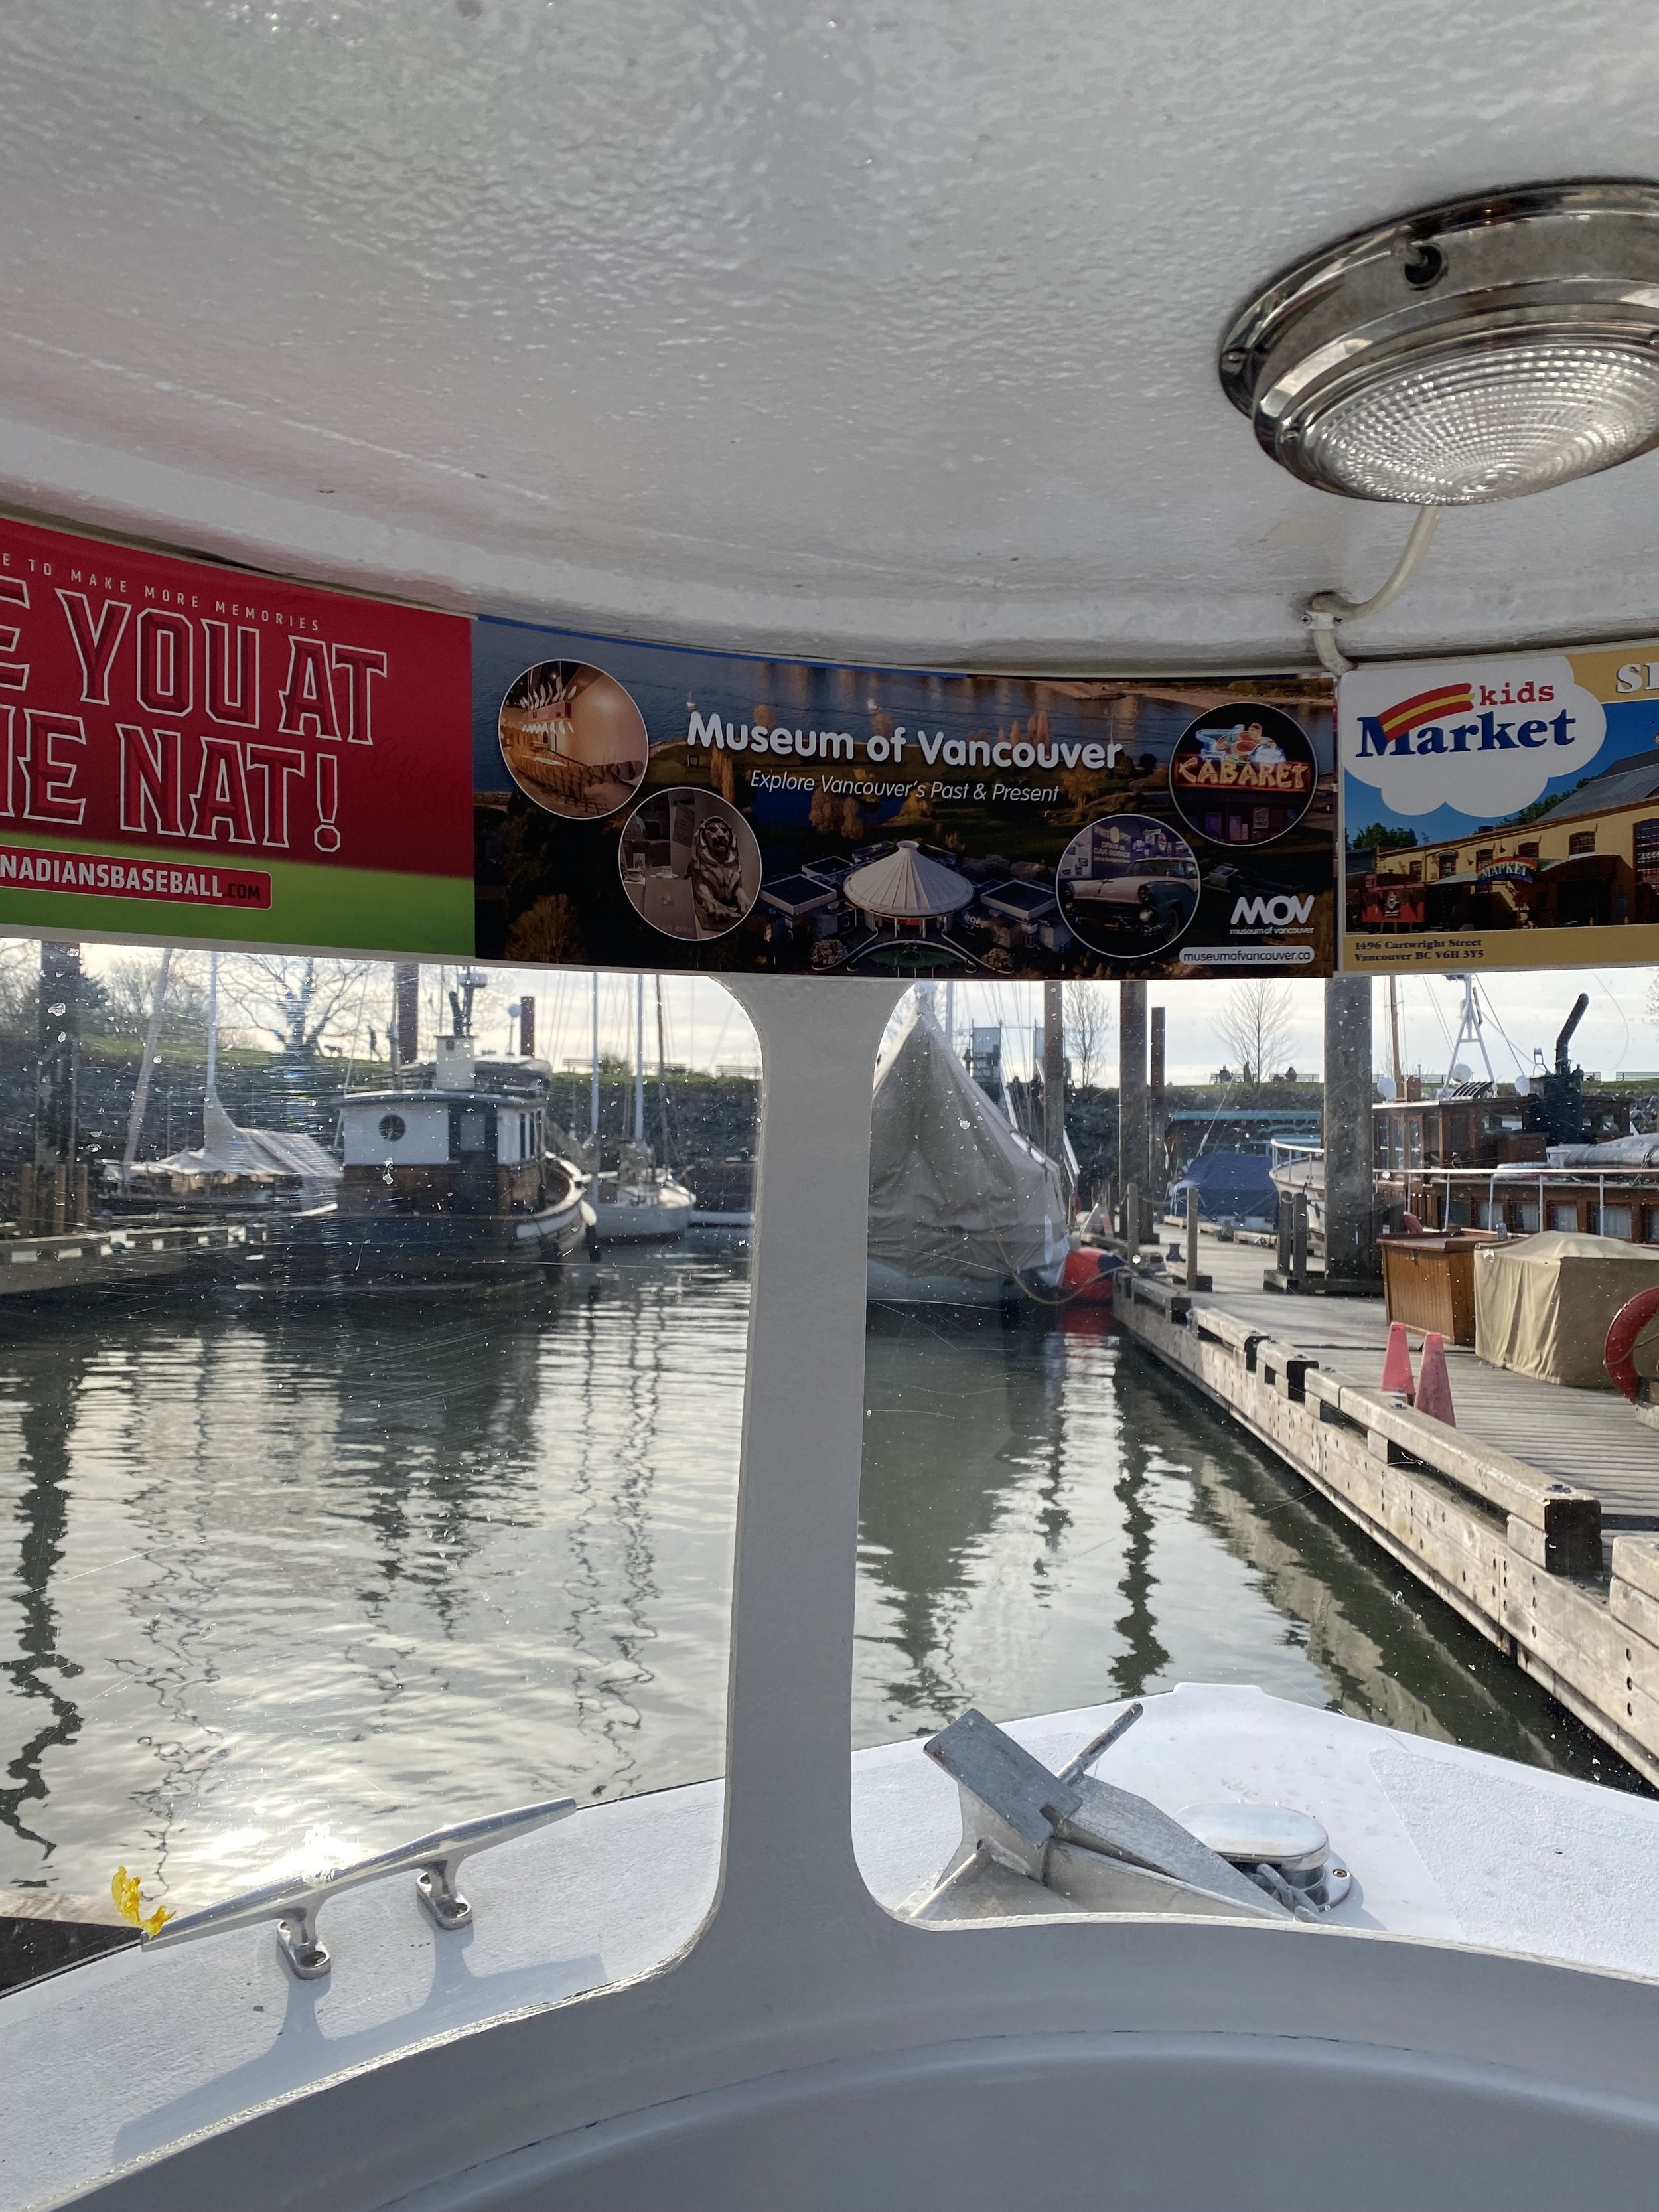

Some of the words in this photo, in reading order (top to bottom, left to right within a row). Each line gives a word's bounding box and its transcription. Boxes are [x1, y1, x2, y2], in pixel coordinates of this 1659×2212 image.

[29, 559, 52, 575] TO
[71, 569, 127, 593] MAKE
[145, 585, 198, 608] MORE
[216, 600, 319, 631] MEMORIES
[54, 587, 259, 729] YOU
[277, 635, 387, 745] AT
[1479, 681, 1555, 706] kids
[687, 711, 854, 760] Museum
[867, 727, 907, 763] of
[918, 731, 1123, 769] Vancouver
[1356, 709, 1576, 757] Market
[0, 704, 86, 825] E
[115, 723, 341, 852] NAT!
[751, 770, 815, 794] Explore
[930, 782, 970, 800] Past
[974, 783, 987, 800] &
[993, 784, 1060, 802] Present
[1179, 757, 1309, 789] CABARET
[1230, 895, 1315, 926] MOV
[1183, 950, 1311, 962] museumofvancouver.ca
[1355, 940, 1382, 950] 1496
[1385, 939, 1446, 950] Cartwright
[1449, 938, 1482, 948] Street
[1355, 953, 1412, 962] Vancouver
[1415, 951, 1432, 960] BC
[1435, 950, 1459, 959] V6H
[1463, 949, 1484, 958] 3Y5
